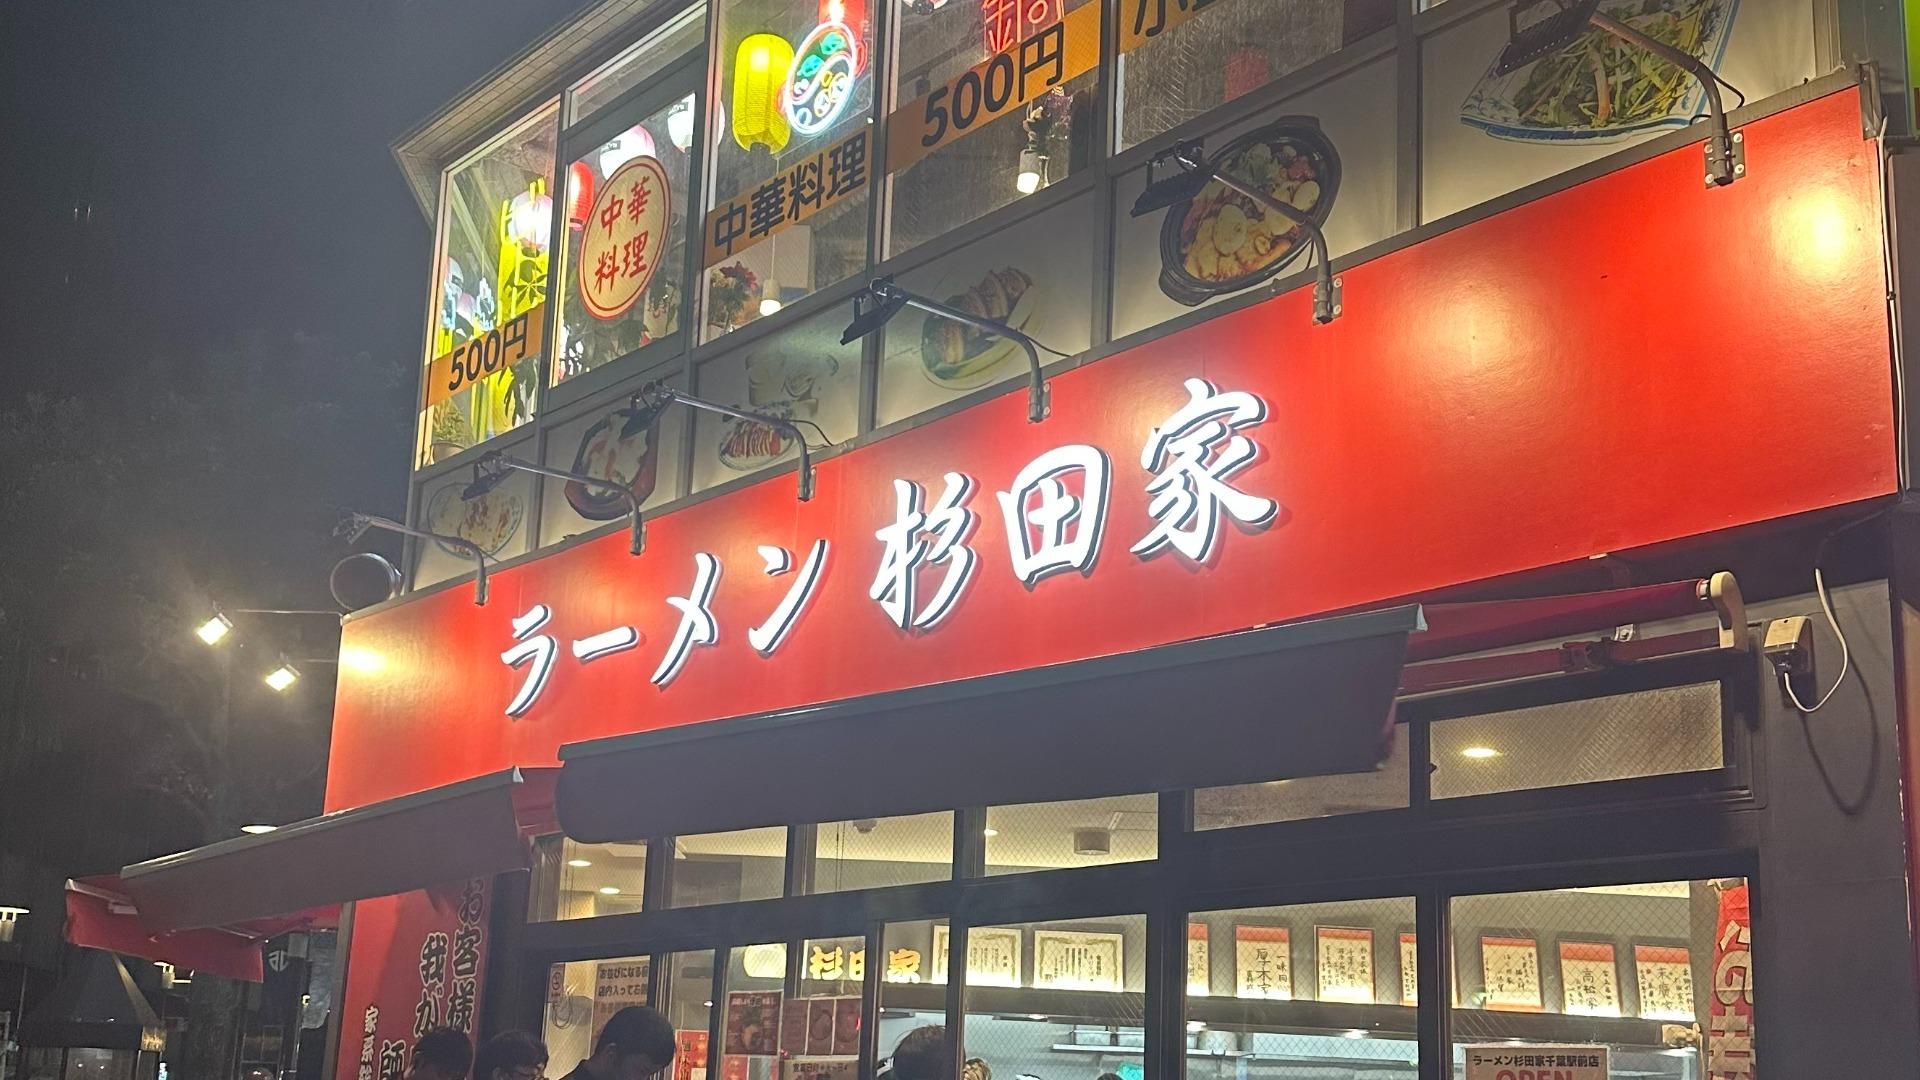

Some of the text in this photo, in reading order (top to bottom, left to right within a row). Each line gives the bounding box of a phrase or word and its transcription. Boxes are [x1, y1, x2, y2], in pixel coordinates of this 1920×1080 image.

[921, 22, 1065, 147] 500円
[600, 176, 651, 238] 中華
[714, 131, 868, 257] 中華料理
[594, 230, 649, 294] 料理
[448, 313, 528, 391] 500円
[500, 377, 1280, 718] ラーメン 杉田家
